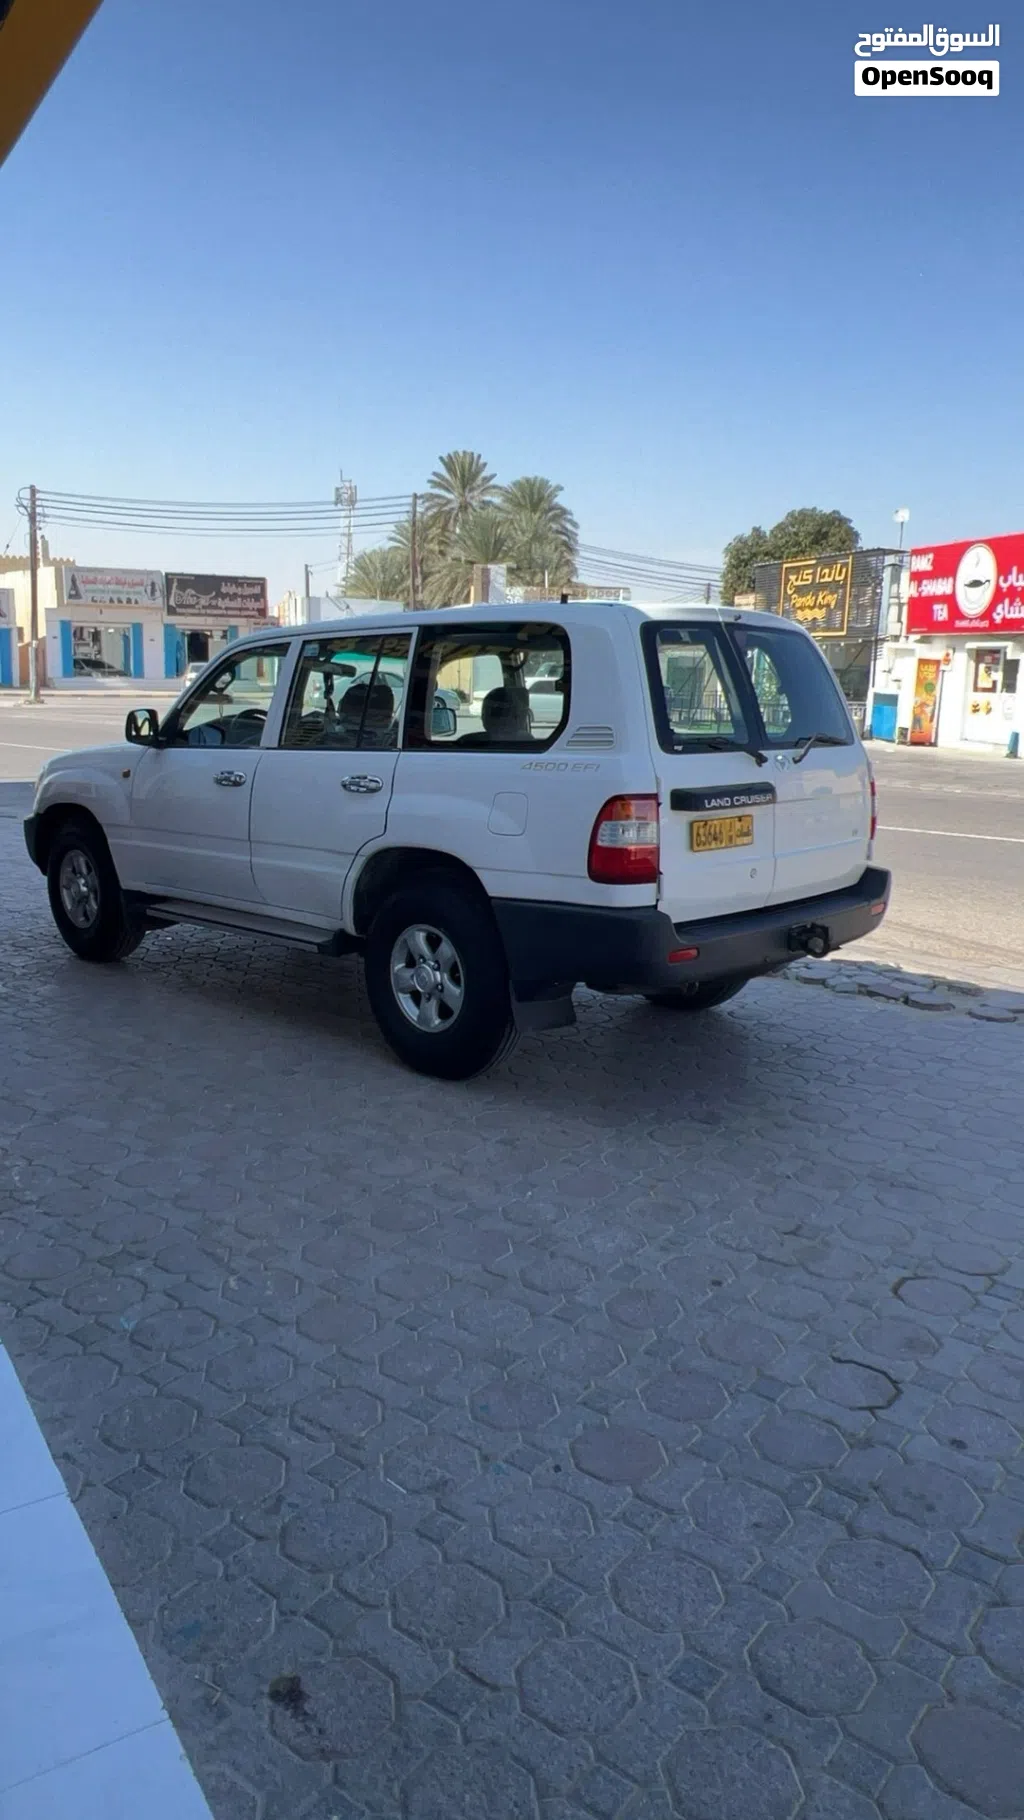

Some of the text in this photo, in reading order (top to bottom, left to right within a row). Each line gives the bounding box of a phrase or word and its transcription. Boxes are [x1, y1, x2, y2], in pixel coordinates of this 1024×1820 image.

[816, 564, 847, 584] باندا
[790, 590, 838, 609] Panda King
[932, 603, 949, 621] TEA
[521, 761, 601, 773] 4500 EFI
[704, 793, 773, 808] LAND CRUISER
